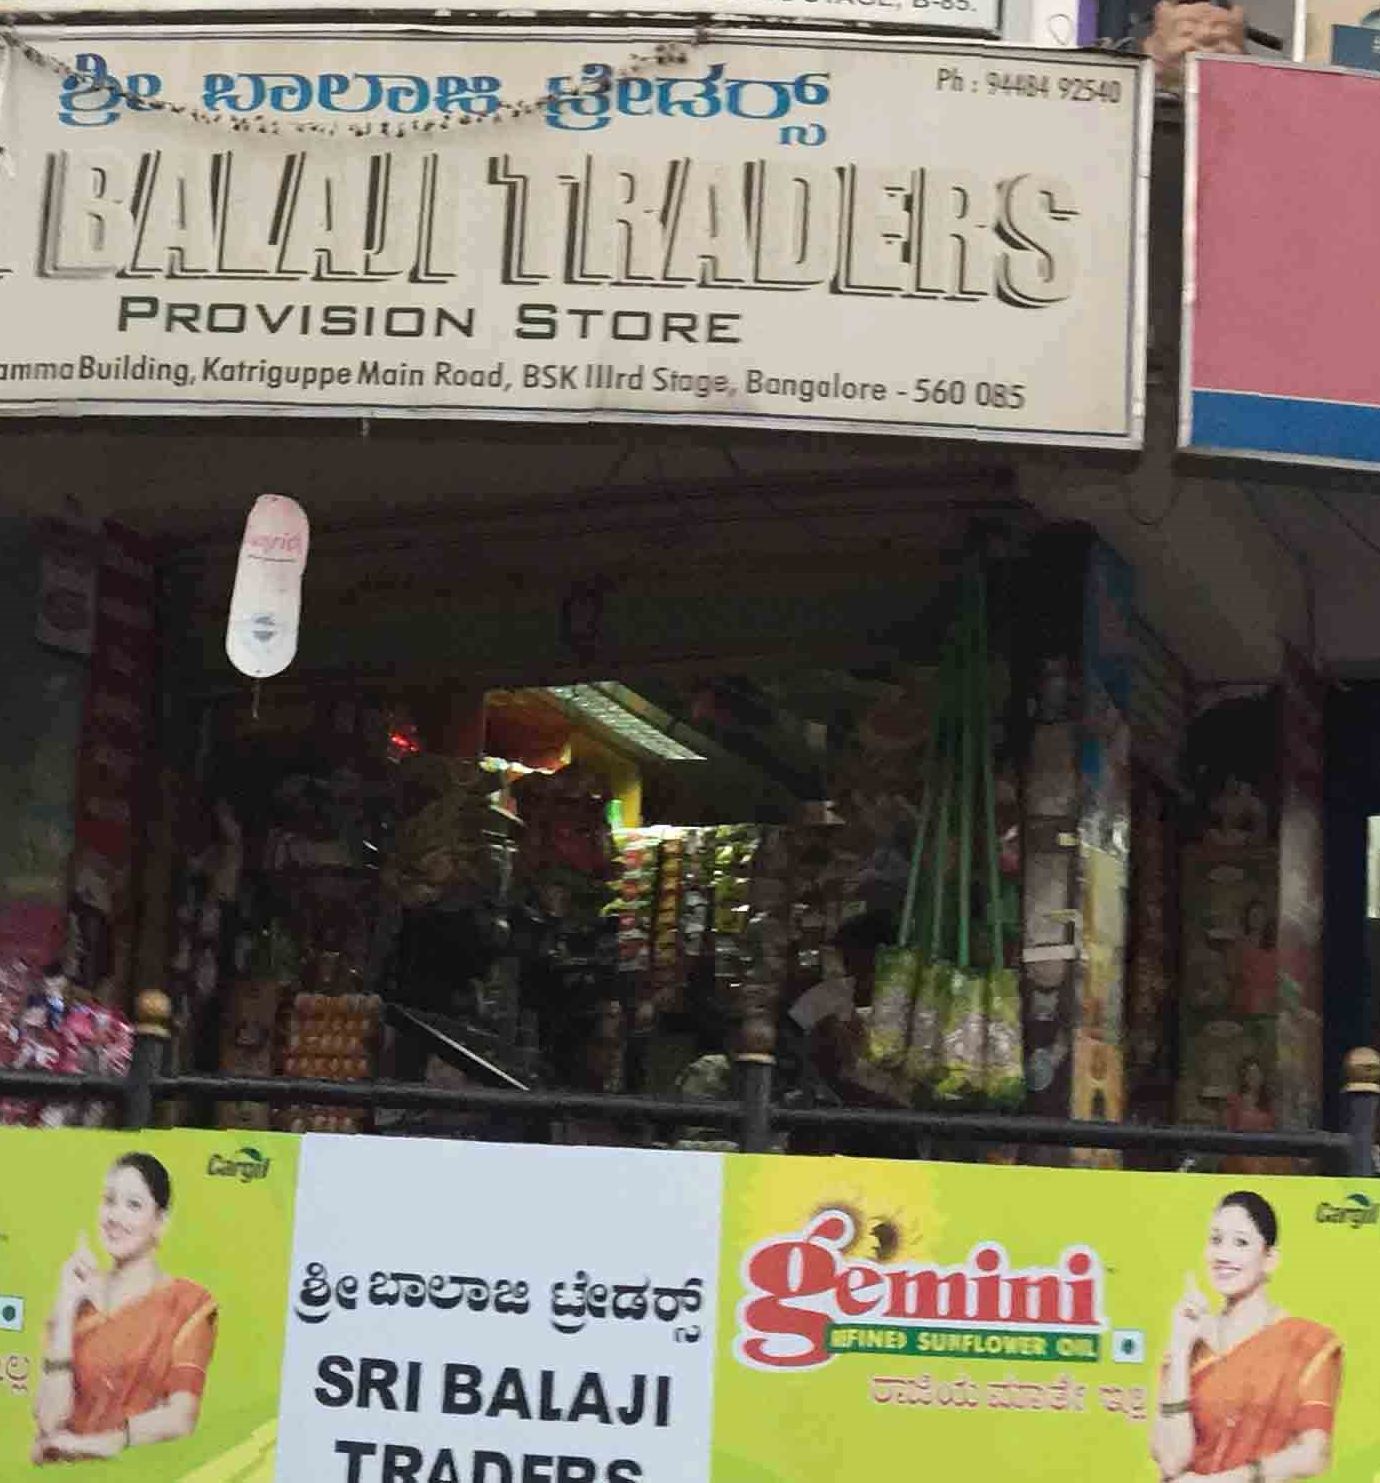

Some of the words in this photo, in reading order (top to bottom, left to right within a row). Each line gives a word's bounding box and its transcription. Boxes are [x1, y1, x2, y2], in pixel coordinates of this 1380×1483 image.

[59, 51, 163, 128] ಶ್ರೀ
[936, 66, 965, 94] Ph
[33, 147, 459, 286] BALAJI
[487, 152, 1081, 310] TRADERS
[118, 294, 476, 341] PROVISION
[514, 301, 744, 346] STORE
[78, 352, 197, 390] Building,
[201, 356, 352, 393] Katriguppe
[356, 357, 427, 390] Main
[433, 362, 515, 394] Road,
[522, 364, 579, 392] BSK
[652, 366, 739, 401] Stage,
[746, 370, 888, 407] Bangalore
[913, 378, 967, 408] 560
[974, 381, 1027, 411] 085
[295, 1261, 358, 1325] ಶ್ರೀ
[741, 1215, 1101, 1367] gemini
[1055, 1337, 1099, 1358] OIL
[314, 1354, 423, 1414] SRI
[441, 1362, 672, 1428] BALAJI
